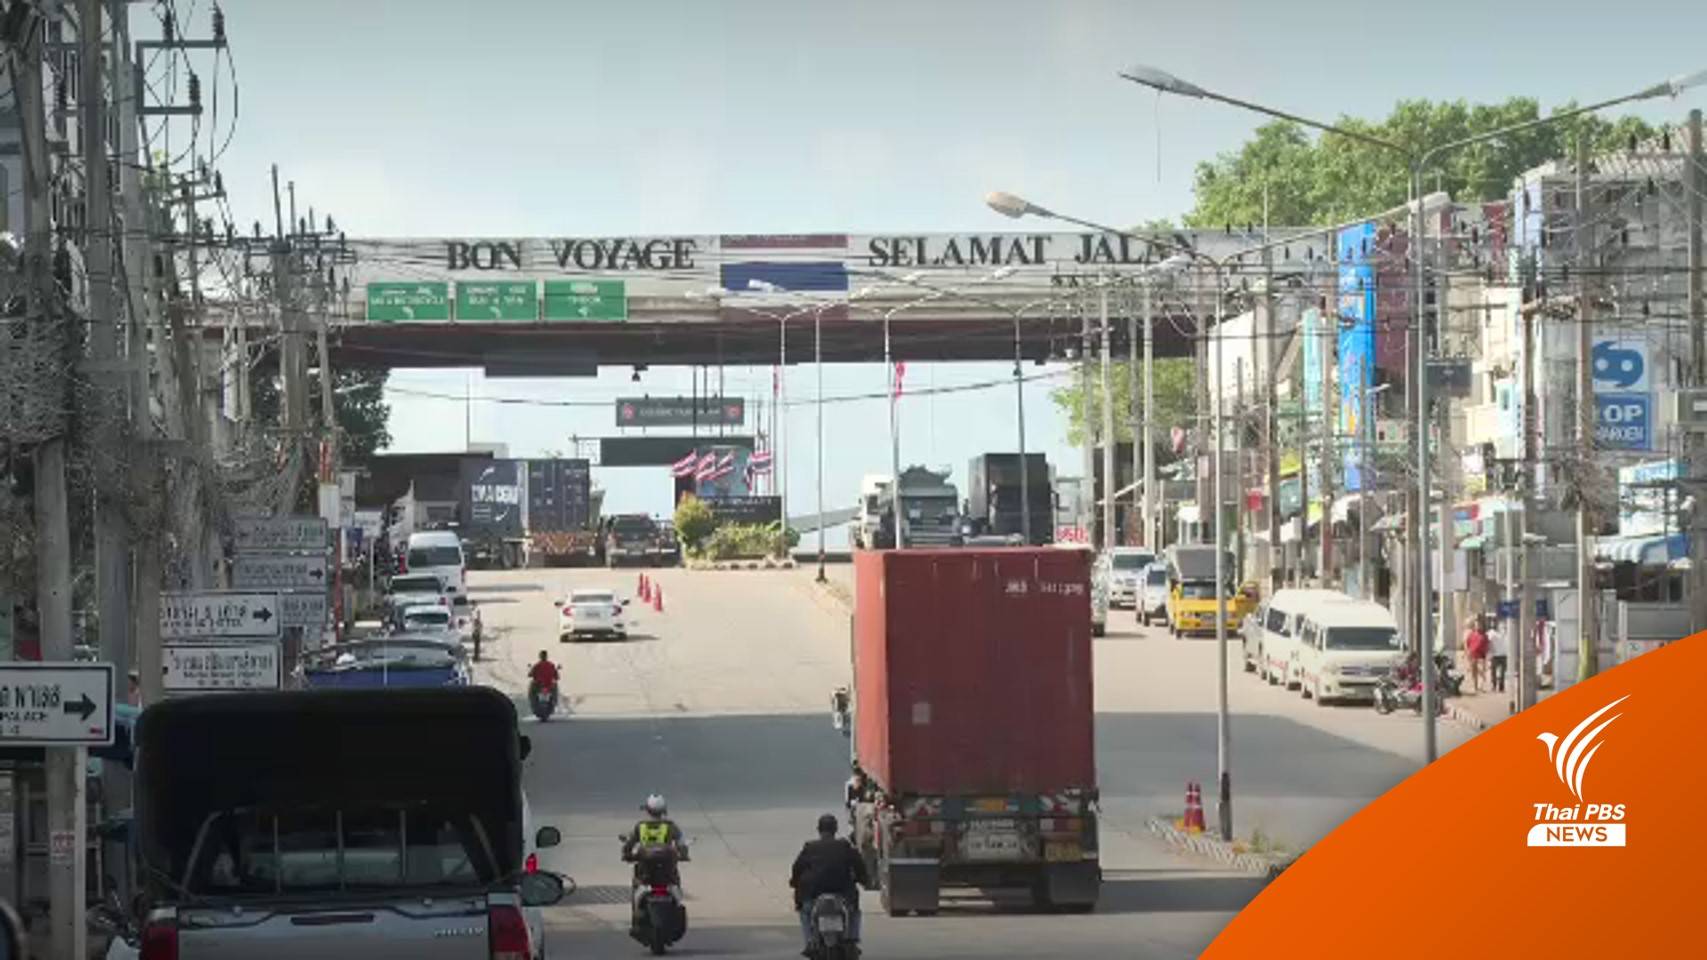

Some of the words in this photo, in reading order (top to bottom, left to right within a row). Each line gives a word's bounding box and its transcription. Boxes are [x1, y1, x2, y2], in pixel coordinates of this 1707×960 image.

[443, 240, 524, 270] BON
[553, 239, 697, 270] VOYAGE
[869, 235, 1051, 266] SELAMAT
